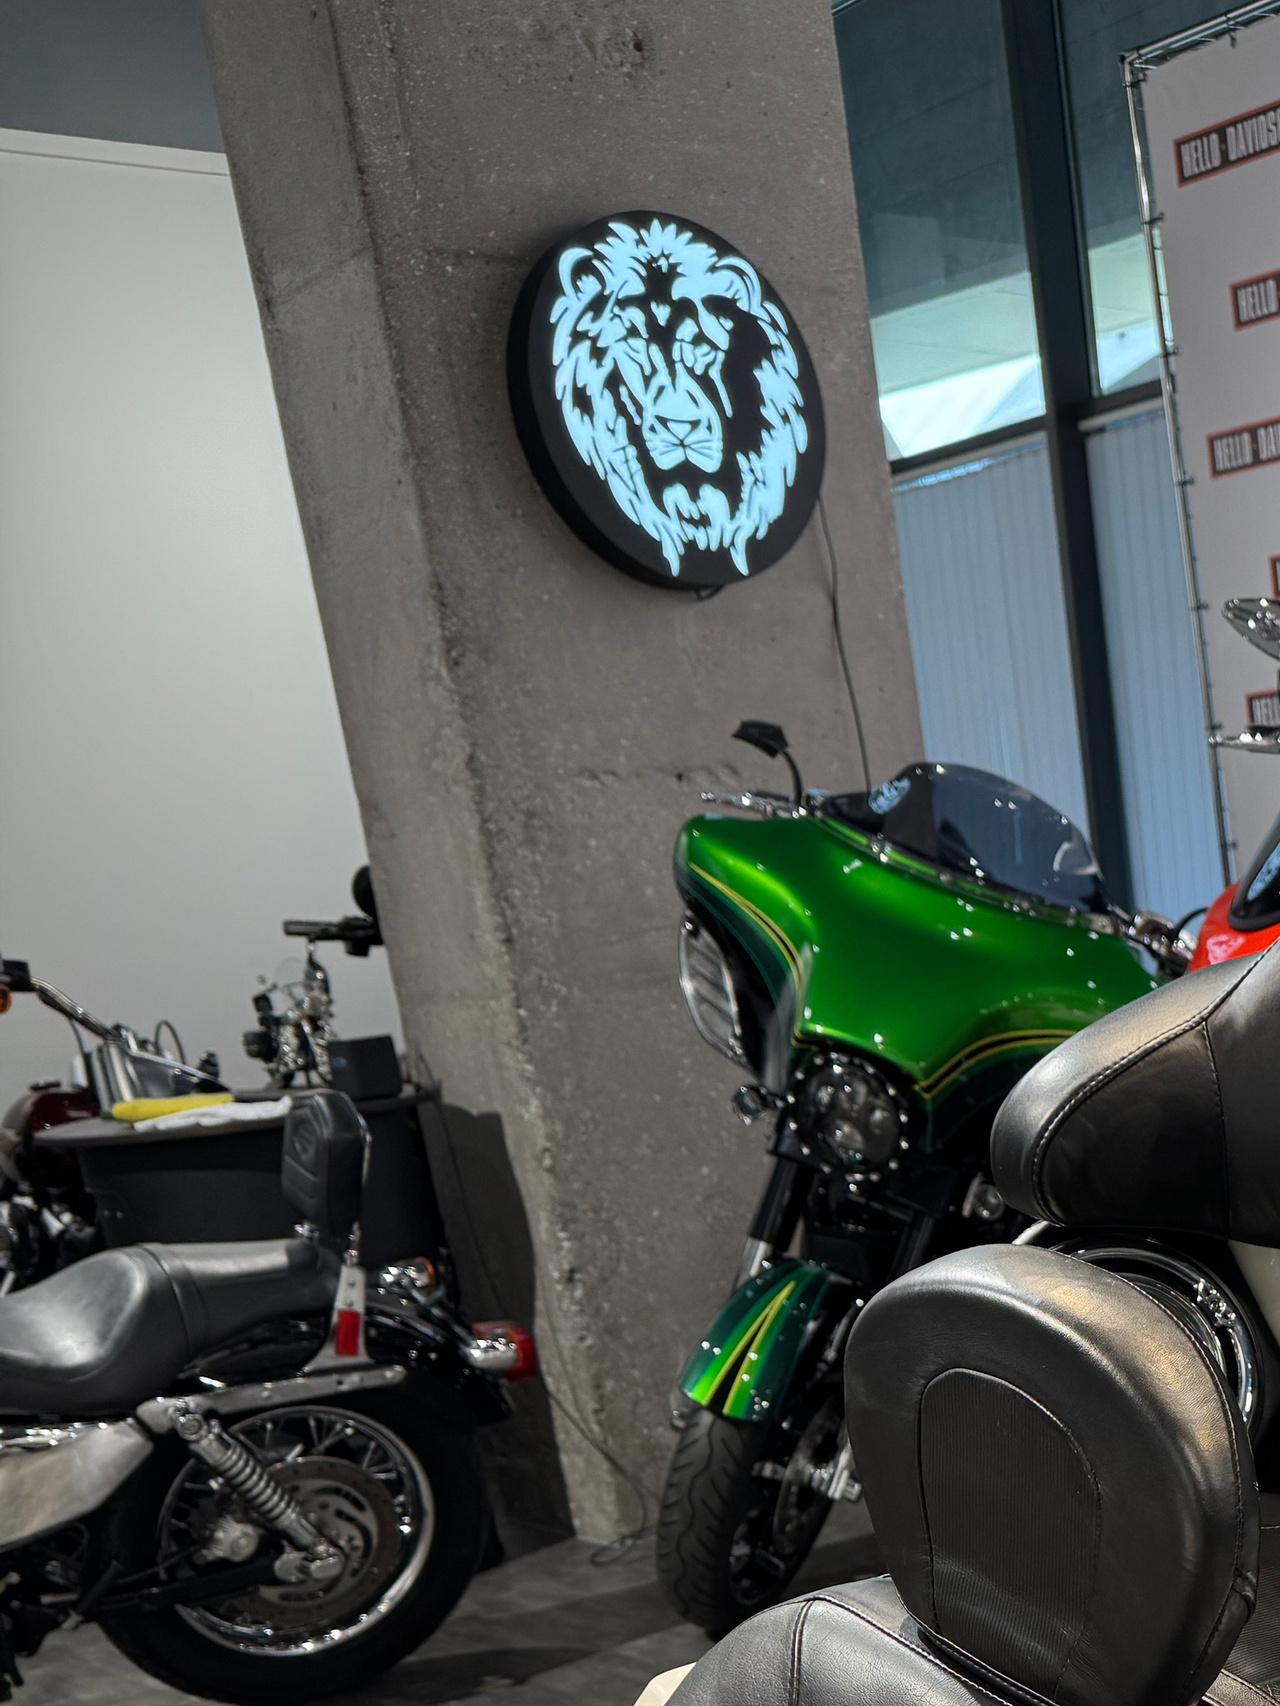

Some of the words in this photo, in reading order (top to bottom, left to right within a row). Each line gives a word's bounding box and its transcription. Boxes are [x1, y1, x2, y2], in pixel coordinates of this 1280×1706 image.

[1180, 133, 1222, 178] HELLO
[1236, 279, 1278, 322] HELLO
[1213, 432, 1253, 472] HELLO
